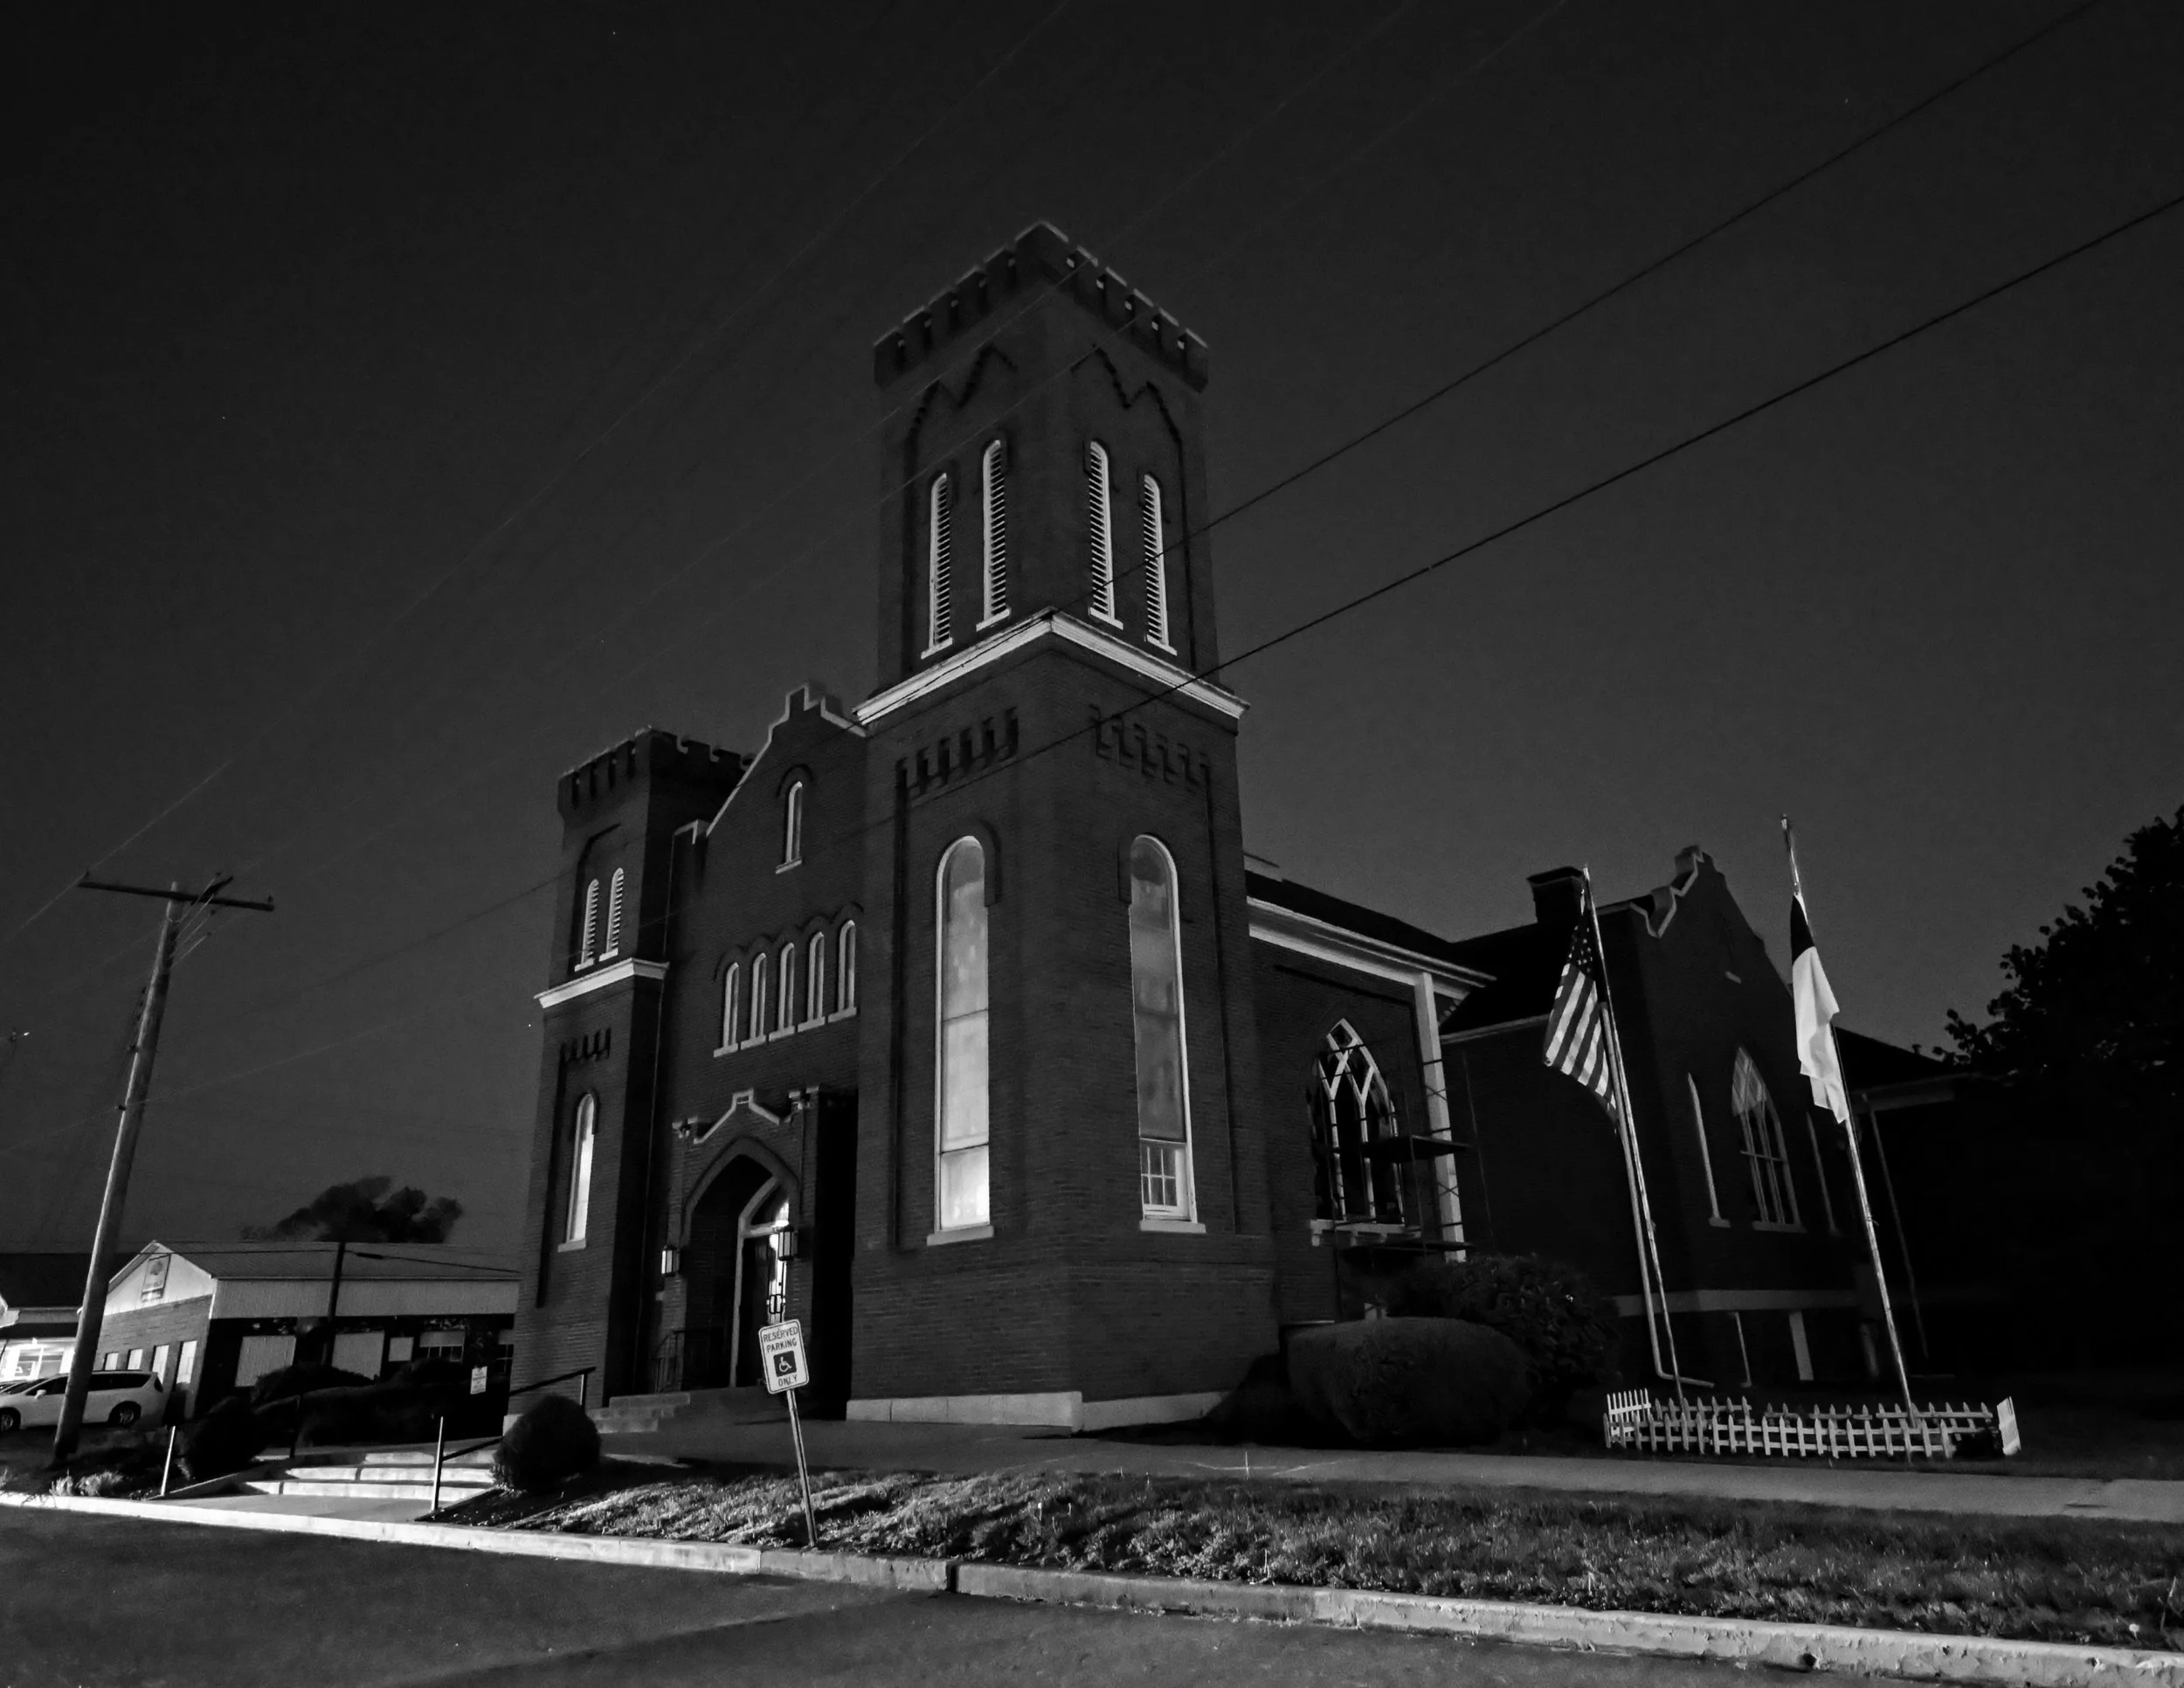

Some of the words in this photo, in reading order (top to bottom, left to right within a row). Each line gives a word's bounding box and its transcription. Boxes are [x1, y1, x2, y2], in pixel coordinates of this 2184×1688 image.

[763, 1326, 798, 1343] RESERVED
[766, 1338, 798, 1353] PARKING
[778, 1373, 798, 1387] ONLY
